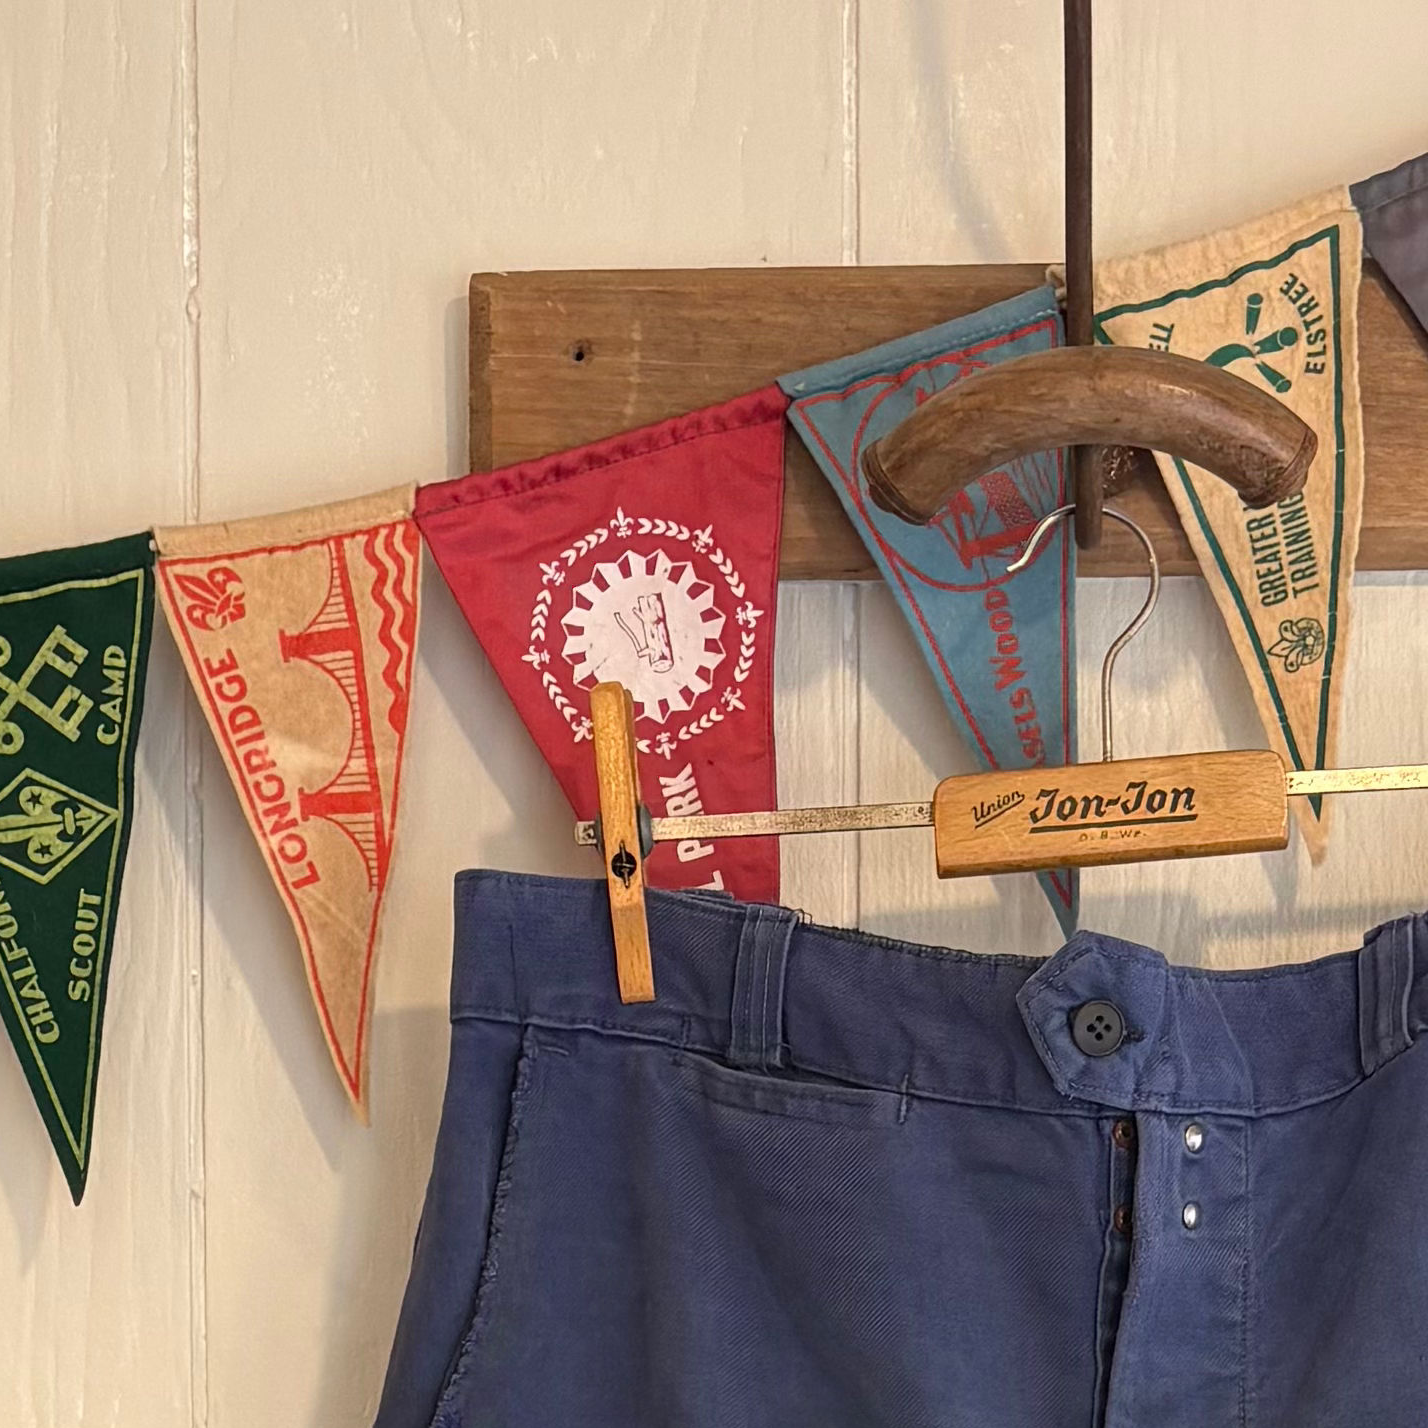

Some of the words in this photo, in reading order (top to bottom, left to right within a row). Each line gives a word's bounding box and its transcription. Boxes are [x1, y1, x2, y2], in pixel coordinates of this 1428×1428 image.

[1279, 272, 1327, 375] ELSTREE
[1246, 512, 1289, 607] GREATER
[203, 648, 321, 890] LONGRIDGE
[658, 762, 715, 863] PRK
[970, 790, 1025, 822] Union
[1029, 781, 1196, 824] Jon-Jon
[68, 888, 102, 1002] SCOUT
[96, 644, 128, 745] CAMP
